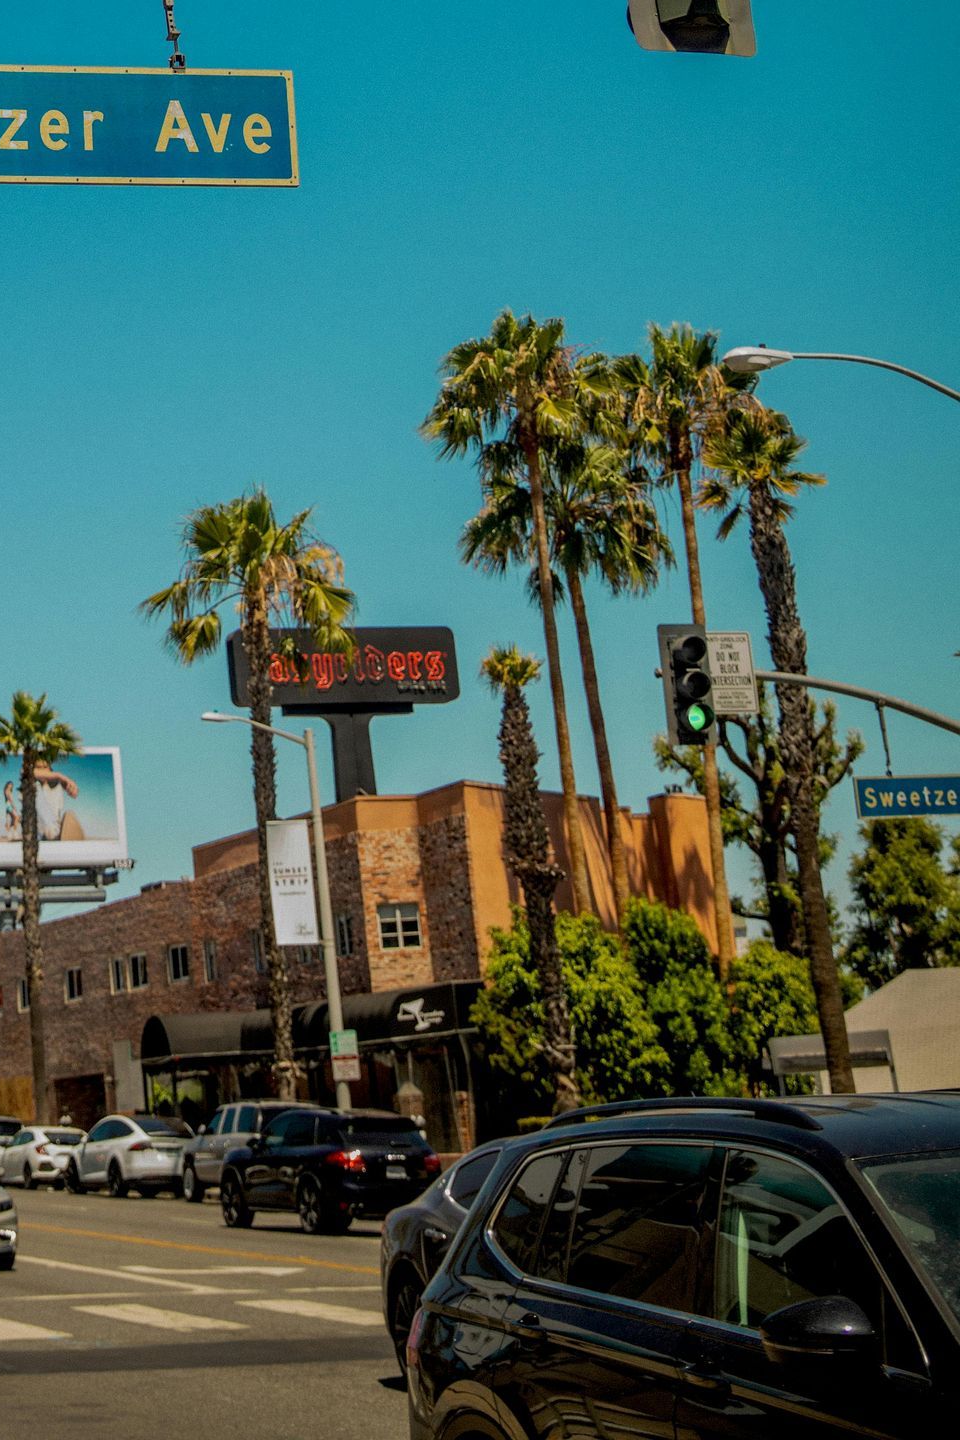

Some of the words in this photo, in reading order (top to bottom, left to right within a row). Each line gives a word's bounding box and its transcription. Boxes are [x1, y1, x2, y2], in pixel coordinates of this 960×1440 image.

[154, 100, 273, 154] Ave
[716, 651, 725, 661] DO
[728, 651, 740, 661] NOT
[269, 644, 445, 689] asyriders
[720, 664, 739, 674] BLOCK
[712, 675, 751, 686] NTERSECTION
[864, 786, 958, 808] Sweetze
[273, 866, 308, 875] SUNSET
[274, 879, 308, 887] STRIP
